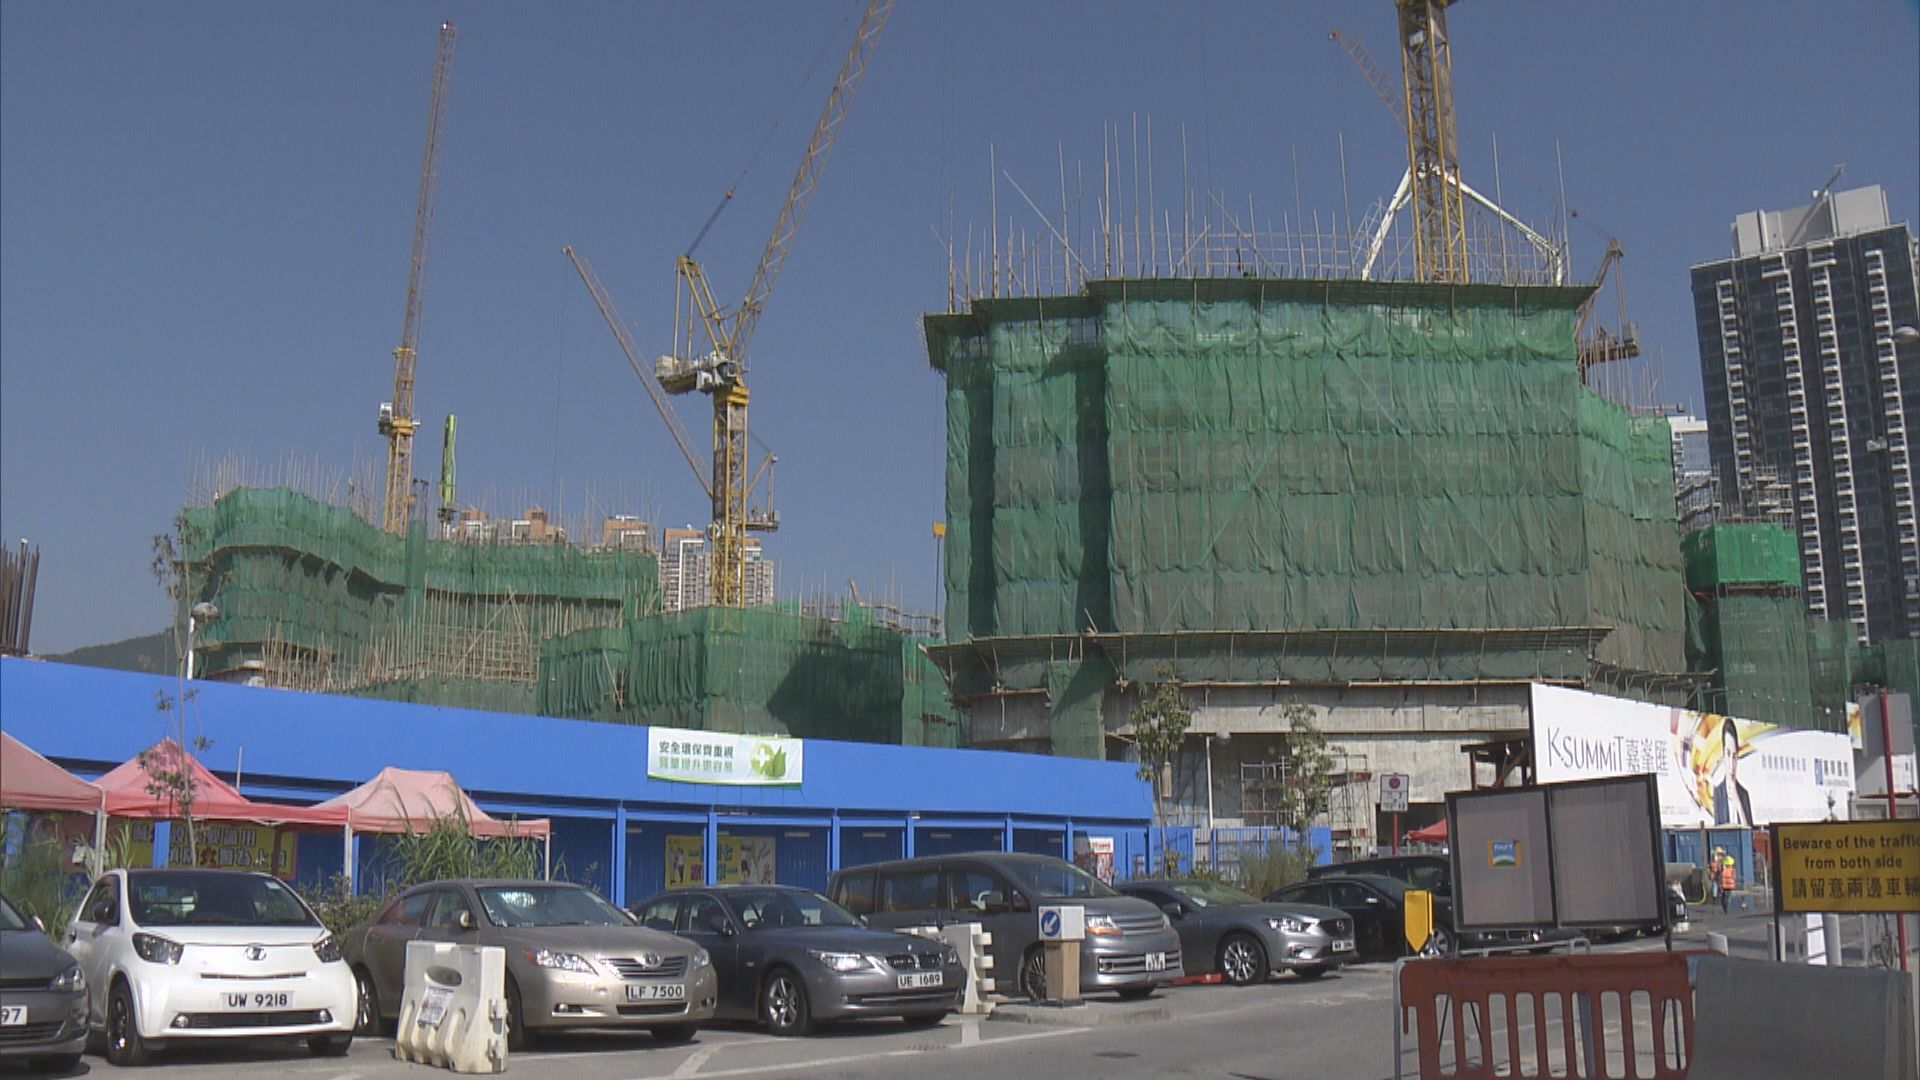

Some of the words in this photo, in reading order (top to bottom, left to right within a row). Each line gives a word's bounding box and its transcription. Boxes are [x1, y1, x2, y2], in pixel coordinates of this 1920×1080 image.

[1783, 836, 1832, 849] Beware
[1836, 835, 1849, 848] of
[1854, 835, 1875, 848] the
[1805, 856, 1835, 869] from
[1840, 856, 1871, 869] both
[1876, 855, 1902, 868] side
[1792, 876, 1920, 898] 請留意兩邊車輛
[900, 975, 913, 986] UE
[919, 974, 940, 985] 1689
[629, 985, 646, 998] LF
[651, 985, 683, 998] 7500
[228, 994, 247, 1007] UW
[255, 993, 287, 1007] 9218
